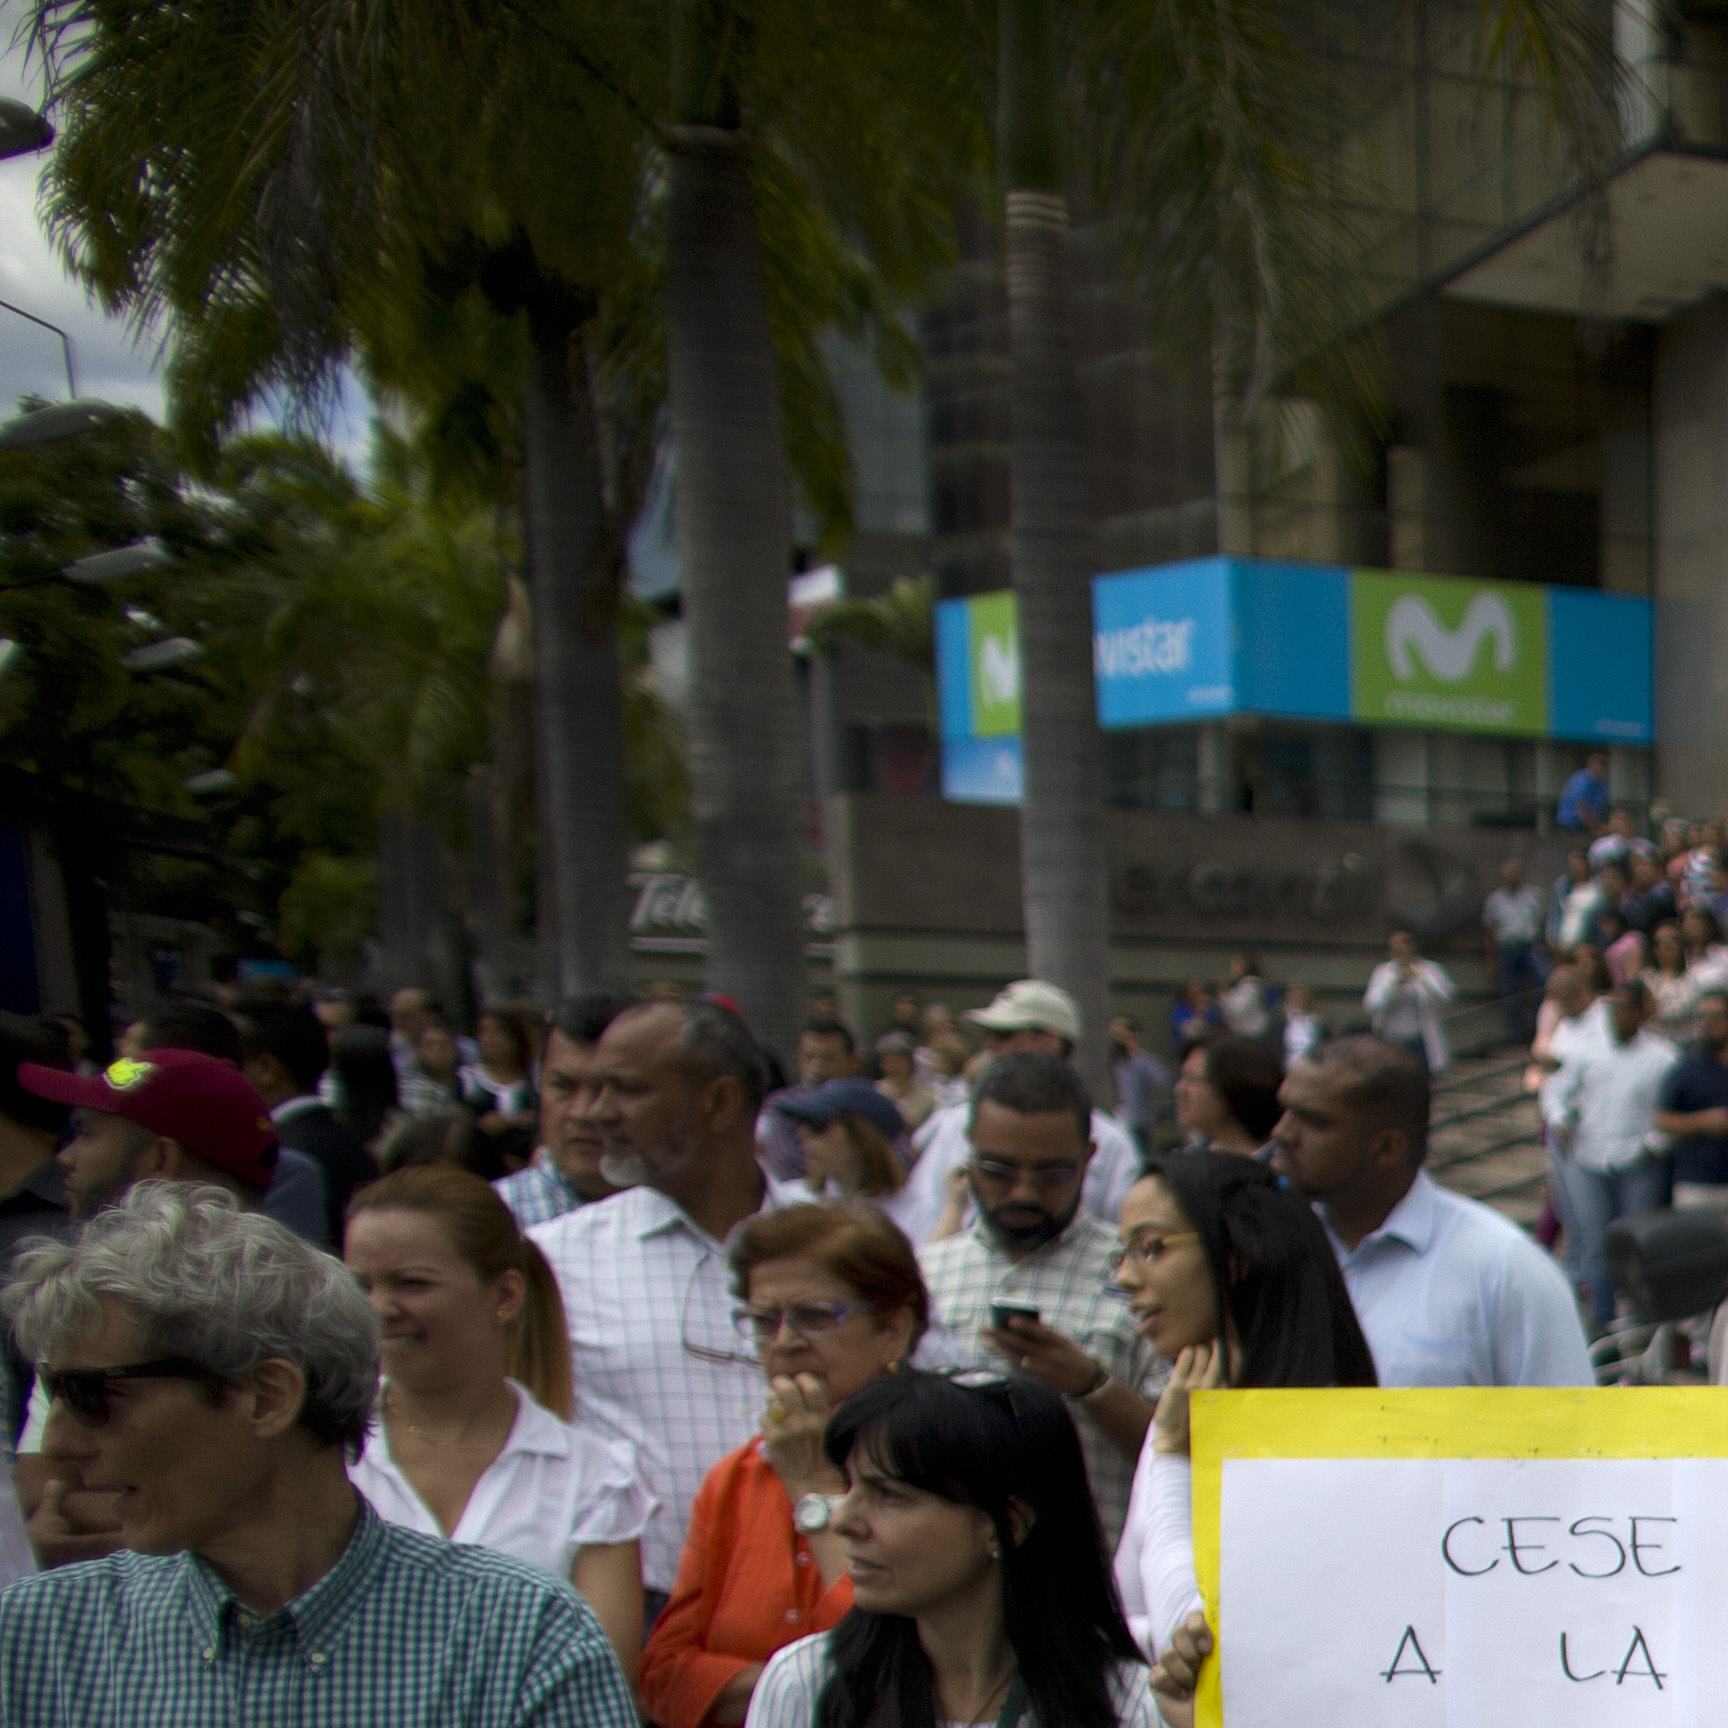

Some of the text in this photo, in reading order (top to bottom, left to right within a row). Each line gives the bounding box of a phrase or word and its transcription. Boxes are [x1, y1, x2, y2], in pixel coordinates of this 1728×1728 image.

[1093, 614, 1193, 677] vistar
[1442, 1515, 1681, 1578] CESE
[1380, 1624, 1667, 1690] A LA
